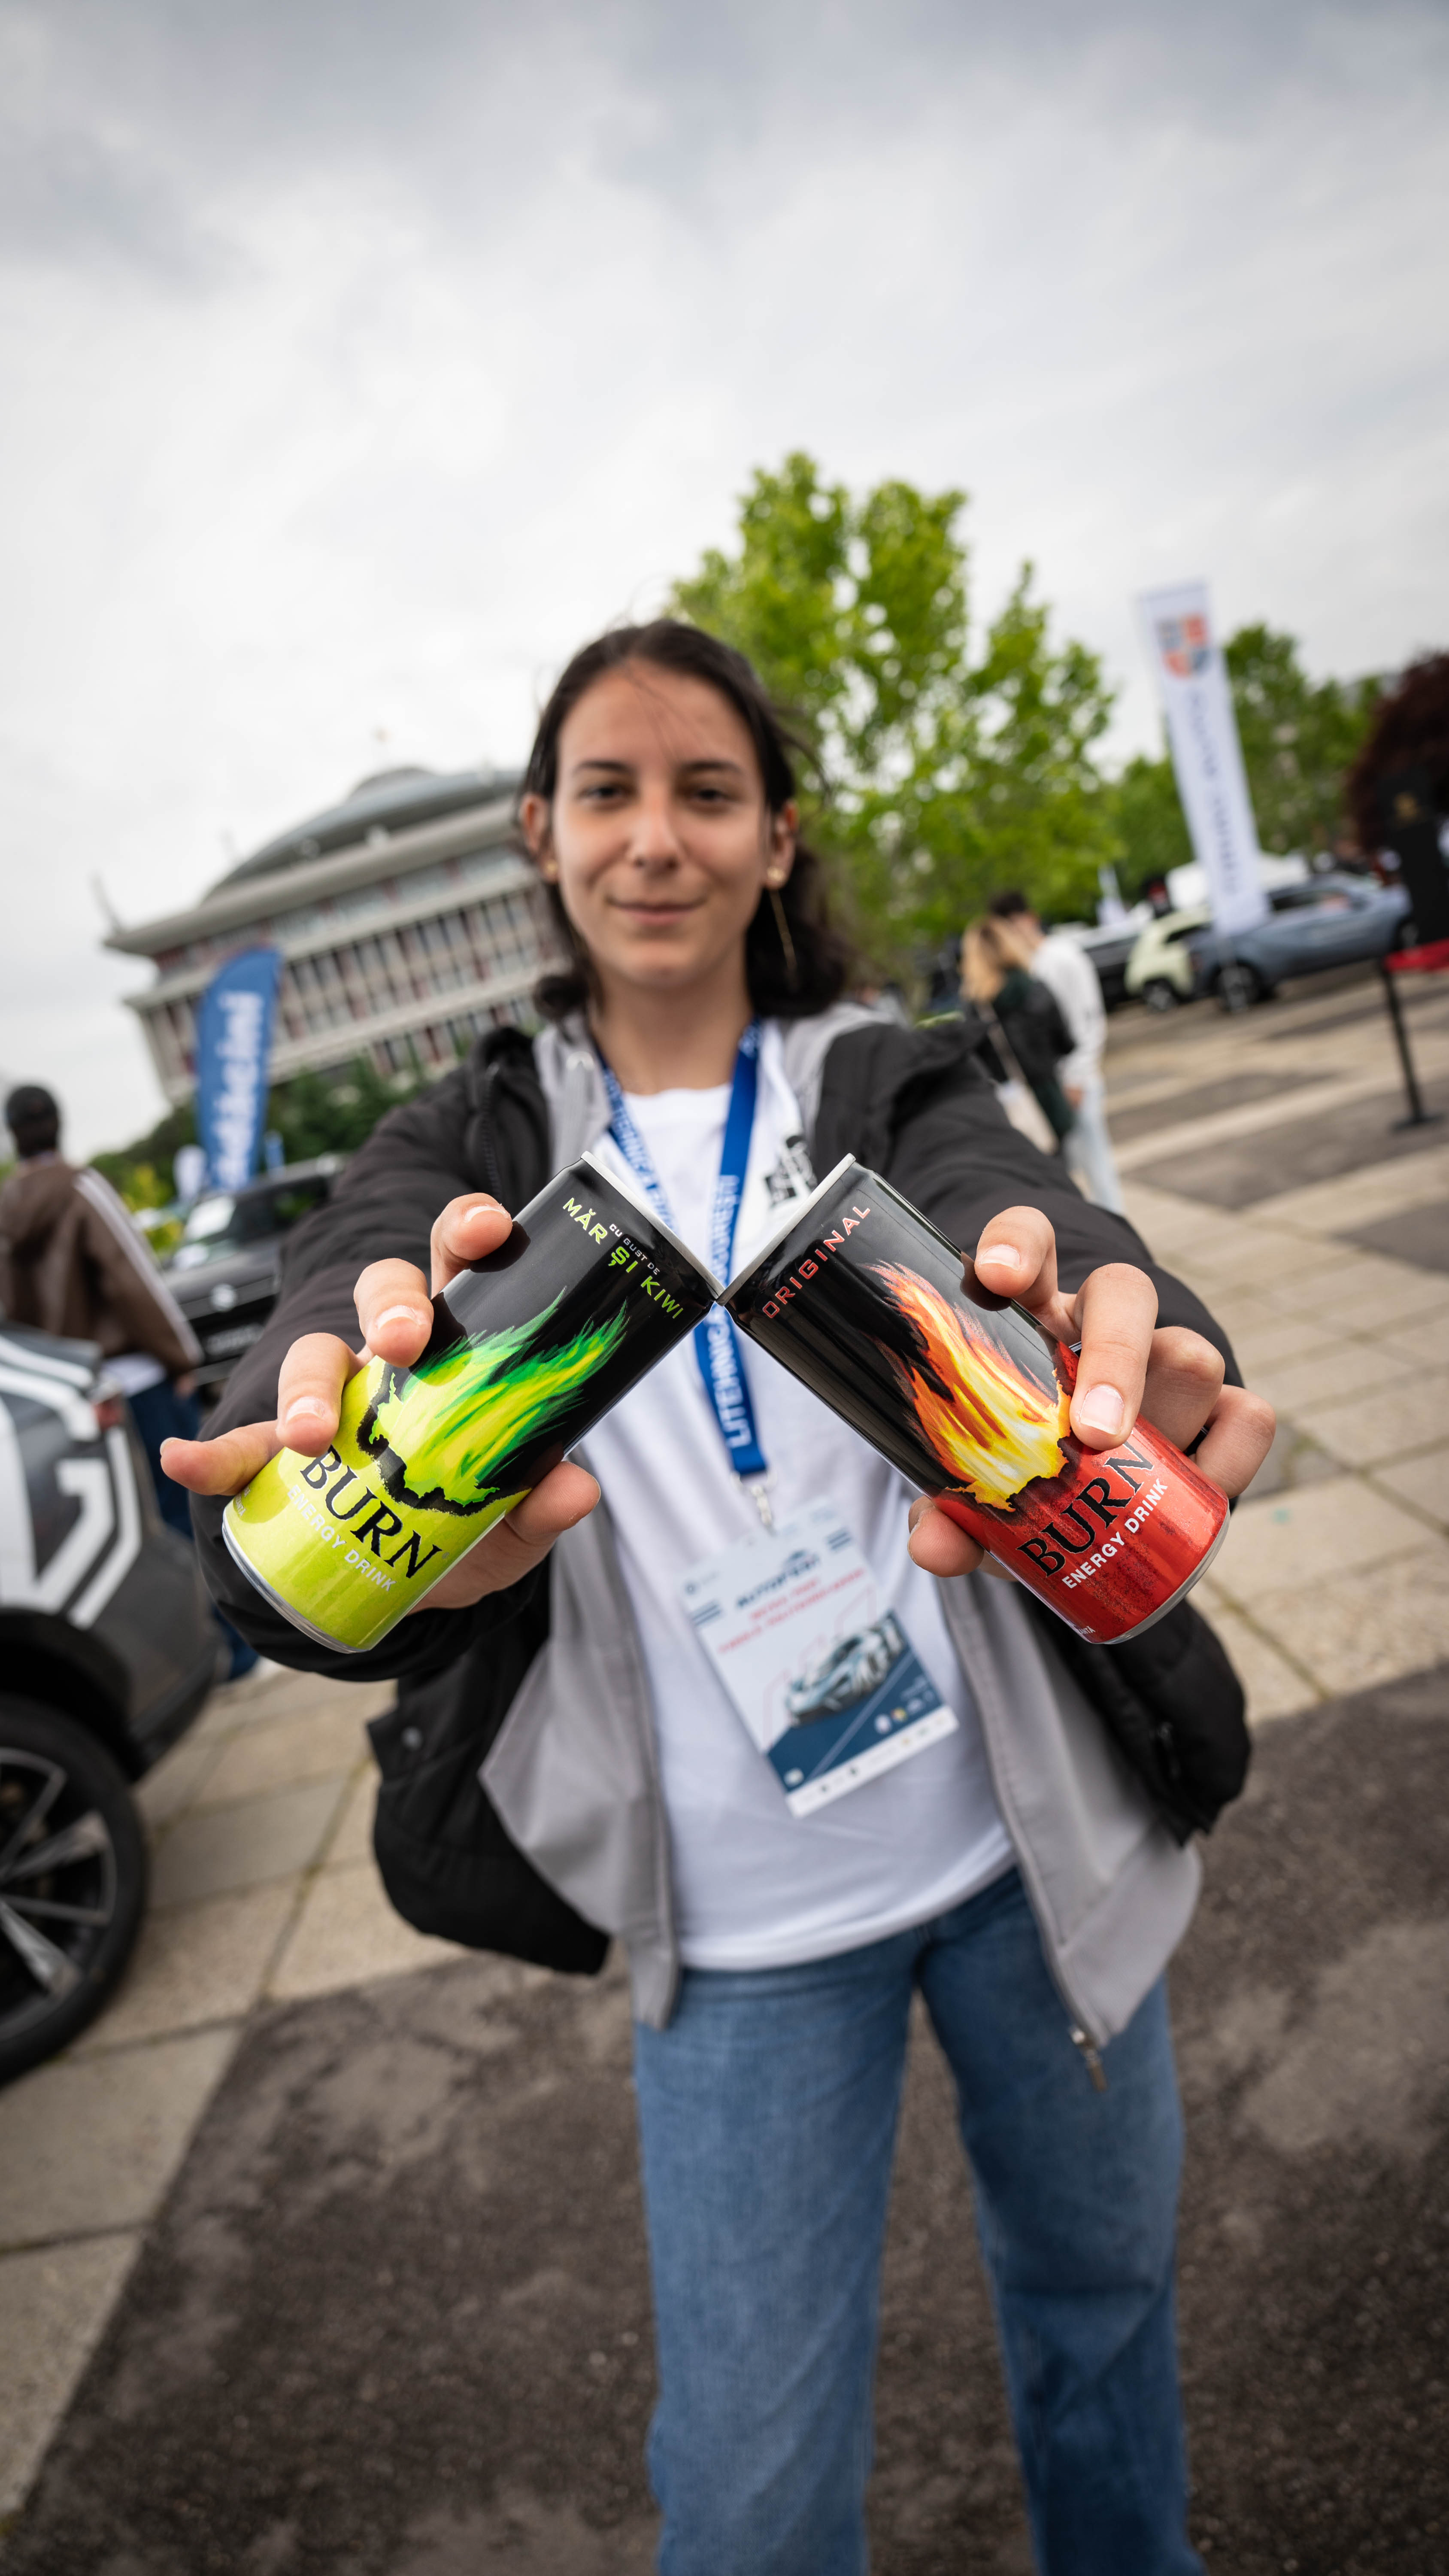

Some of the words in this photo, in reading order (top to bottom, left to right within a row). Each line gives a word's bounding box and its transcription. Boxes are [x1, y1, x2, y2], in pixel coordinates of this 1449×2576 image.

[563, 1197, 608, 1244] MĂR
[608, 1246, 638, 1273] ȘI
[641, 1276, 684, 1319] KIWI
[609, 1224, 622, 1237] CU
[623, 1238, 647, 1261] GUST
[647, 1262, 660, 1275] DE
[762, 1206, 870, 1318] ORIGINAL
[287, 1485, 347, 1549] ENERGY
[345, 1549, 397, 1592] DRINK
[300, 1444, 443, 1579] BURN
[1016, 1441, 1154, 1578] BURN
[1062, 1531, 1125, 1589] ENERGY
[1125, 1478, 1168, 1534] DRINK
